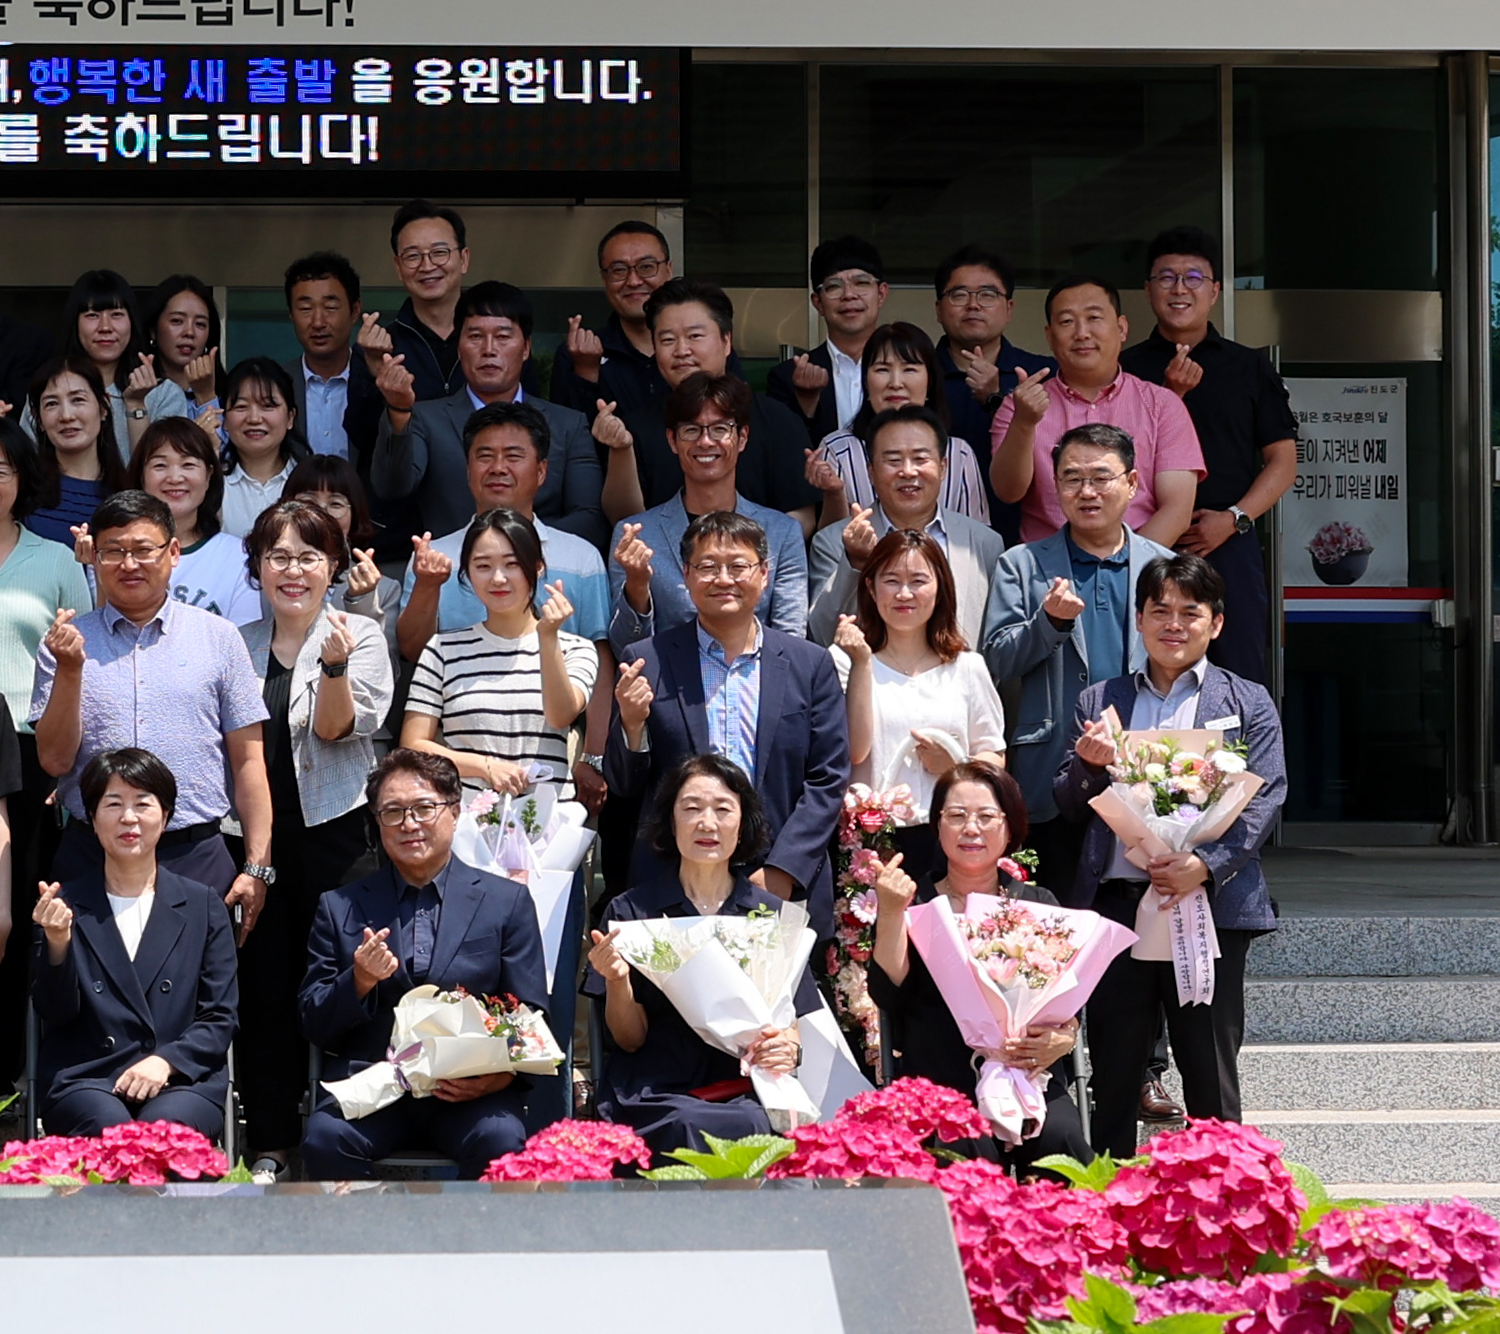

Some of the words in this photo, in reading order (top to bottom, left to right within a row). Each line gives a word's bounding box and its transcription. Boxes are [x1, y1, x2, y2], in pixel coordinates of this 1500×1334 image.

[182, 58, 226, 104] 새
[412, 58, 651, 105] 응원합니다.
[64, 113, 379, 164] 축하드립니다!
[1321, 411, 1375, 424] 호국보훈의
[1377, 411, 1388, 423] 달
[1322, 438, 1359, 464] 지켜낸
[1363, 438, 1387, 464] 어제
[1293, 474, 1332, 500] 우리가
[1335, 474, 1371, 500] 피워낼
[1375, 474, 1399, 500] 내일
